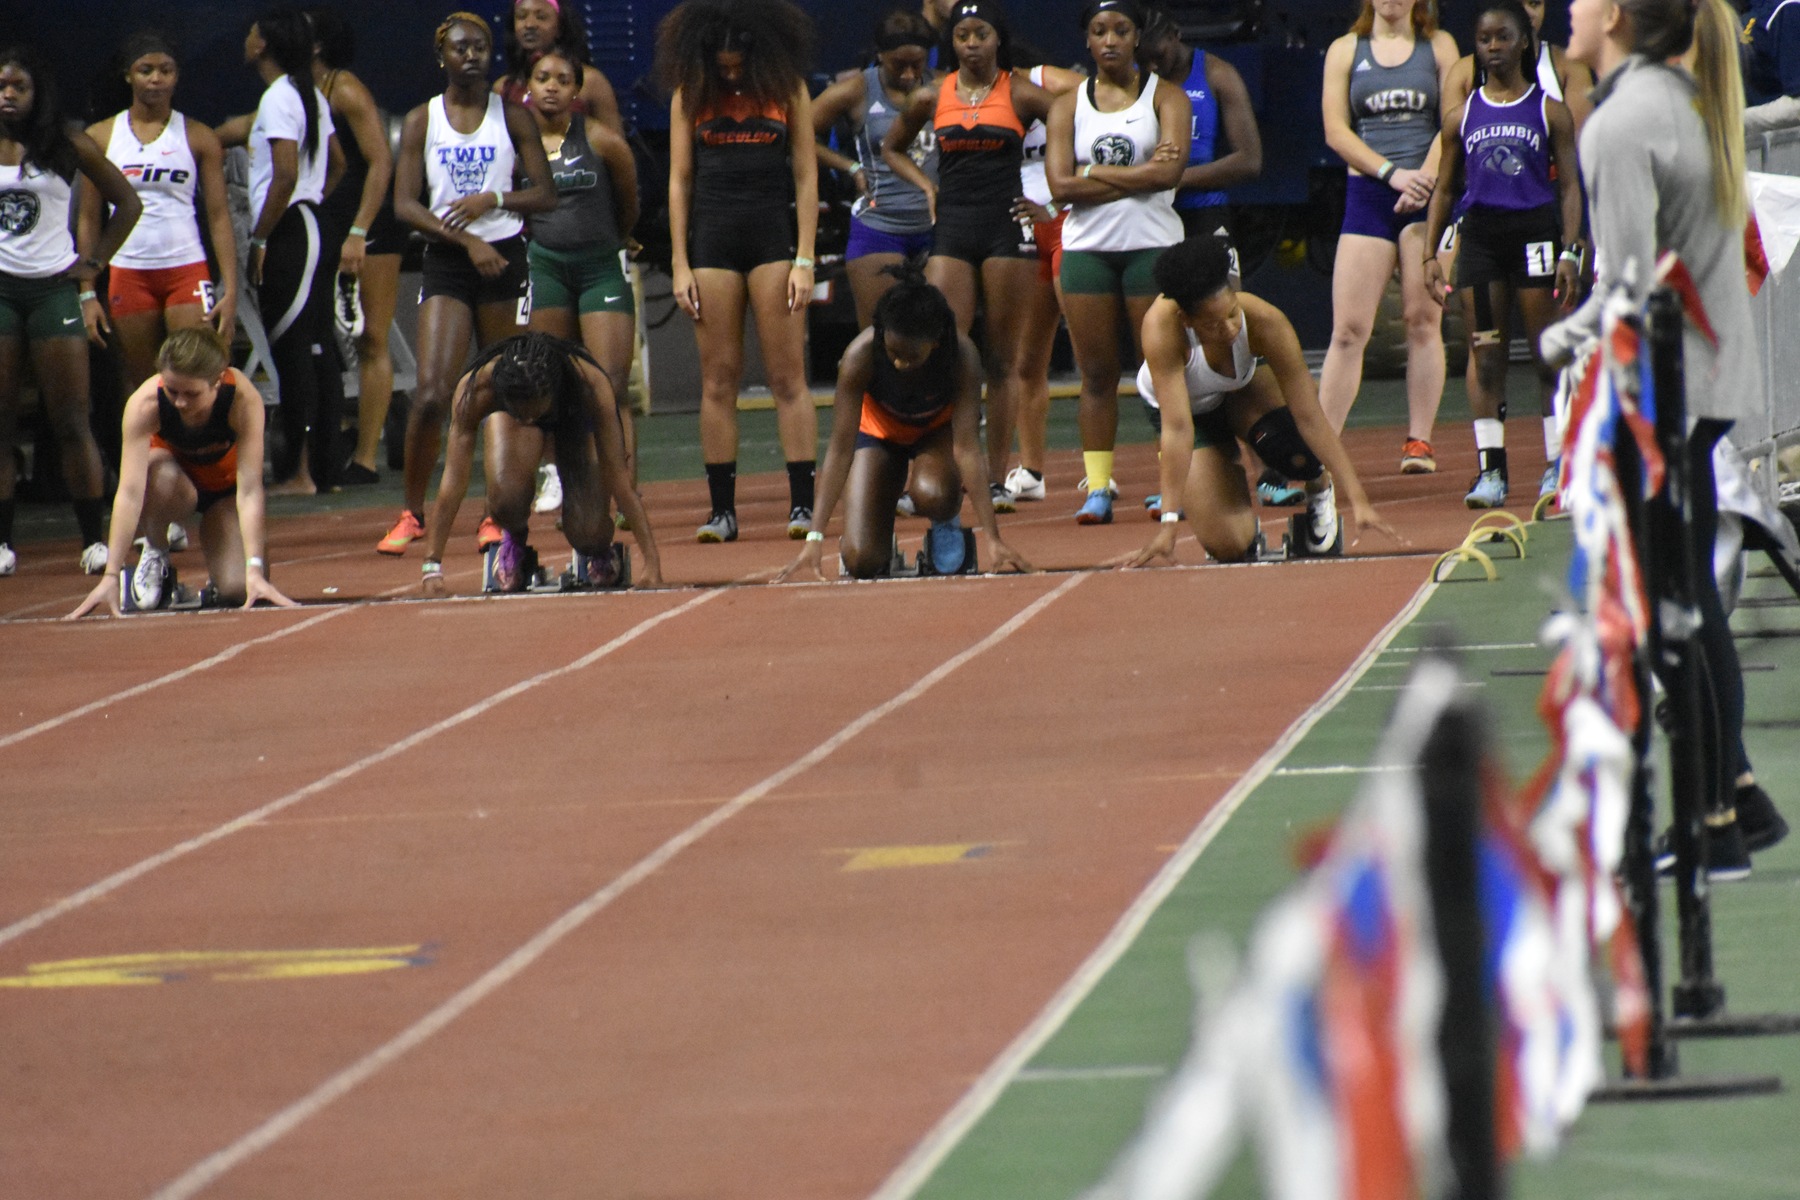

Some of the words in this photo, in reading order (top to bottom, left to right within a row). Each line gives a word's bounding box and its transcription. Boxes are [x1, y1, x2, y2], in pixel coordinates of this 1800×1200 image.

[1365, 89, 1427, 113] WCU
[1466, 126, 1540, 154] COLUMBIA
[438, 146, 496, 164] TWU
[122, 163, 190, 184] Fire
[1445, 224, 1455, 250] 2
[1535, 244, 1547, 273] 1
[520, 296, 530, 323] 4
